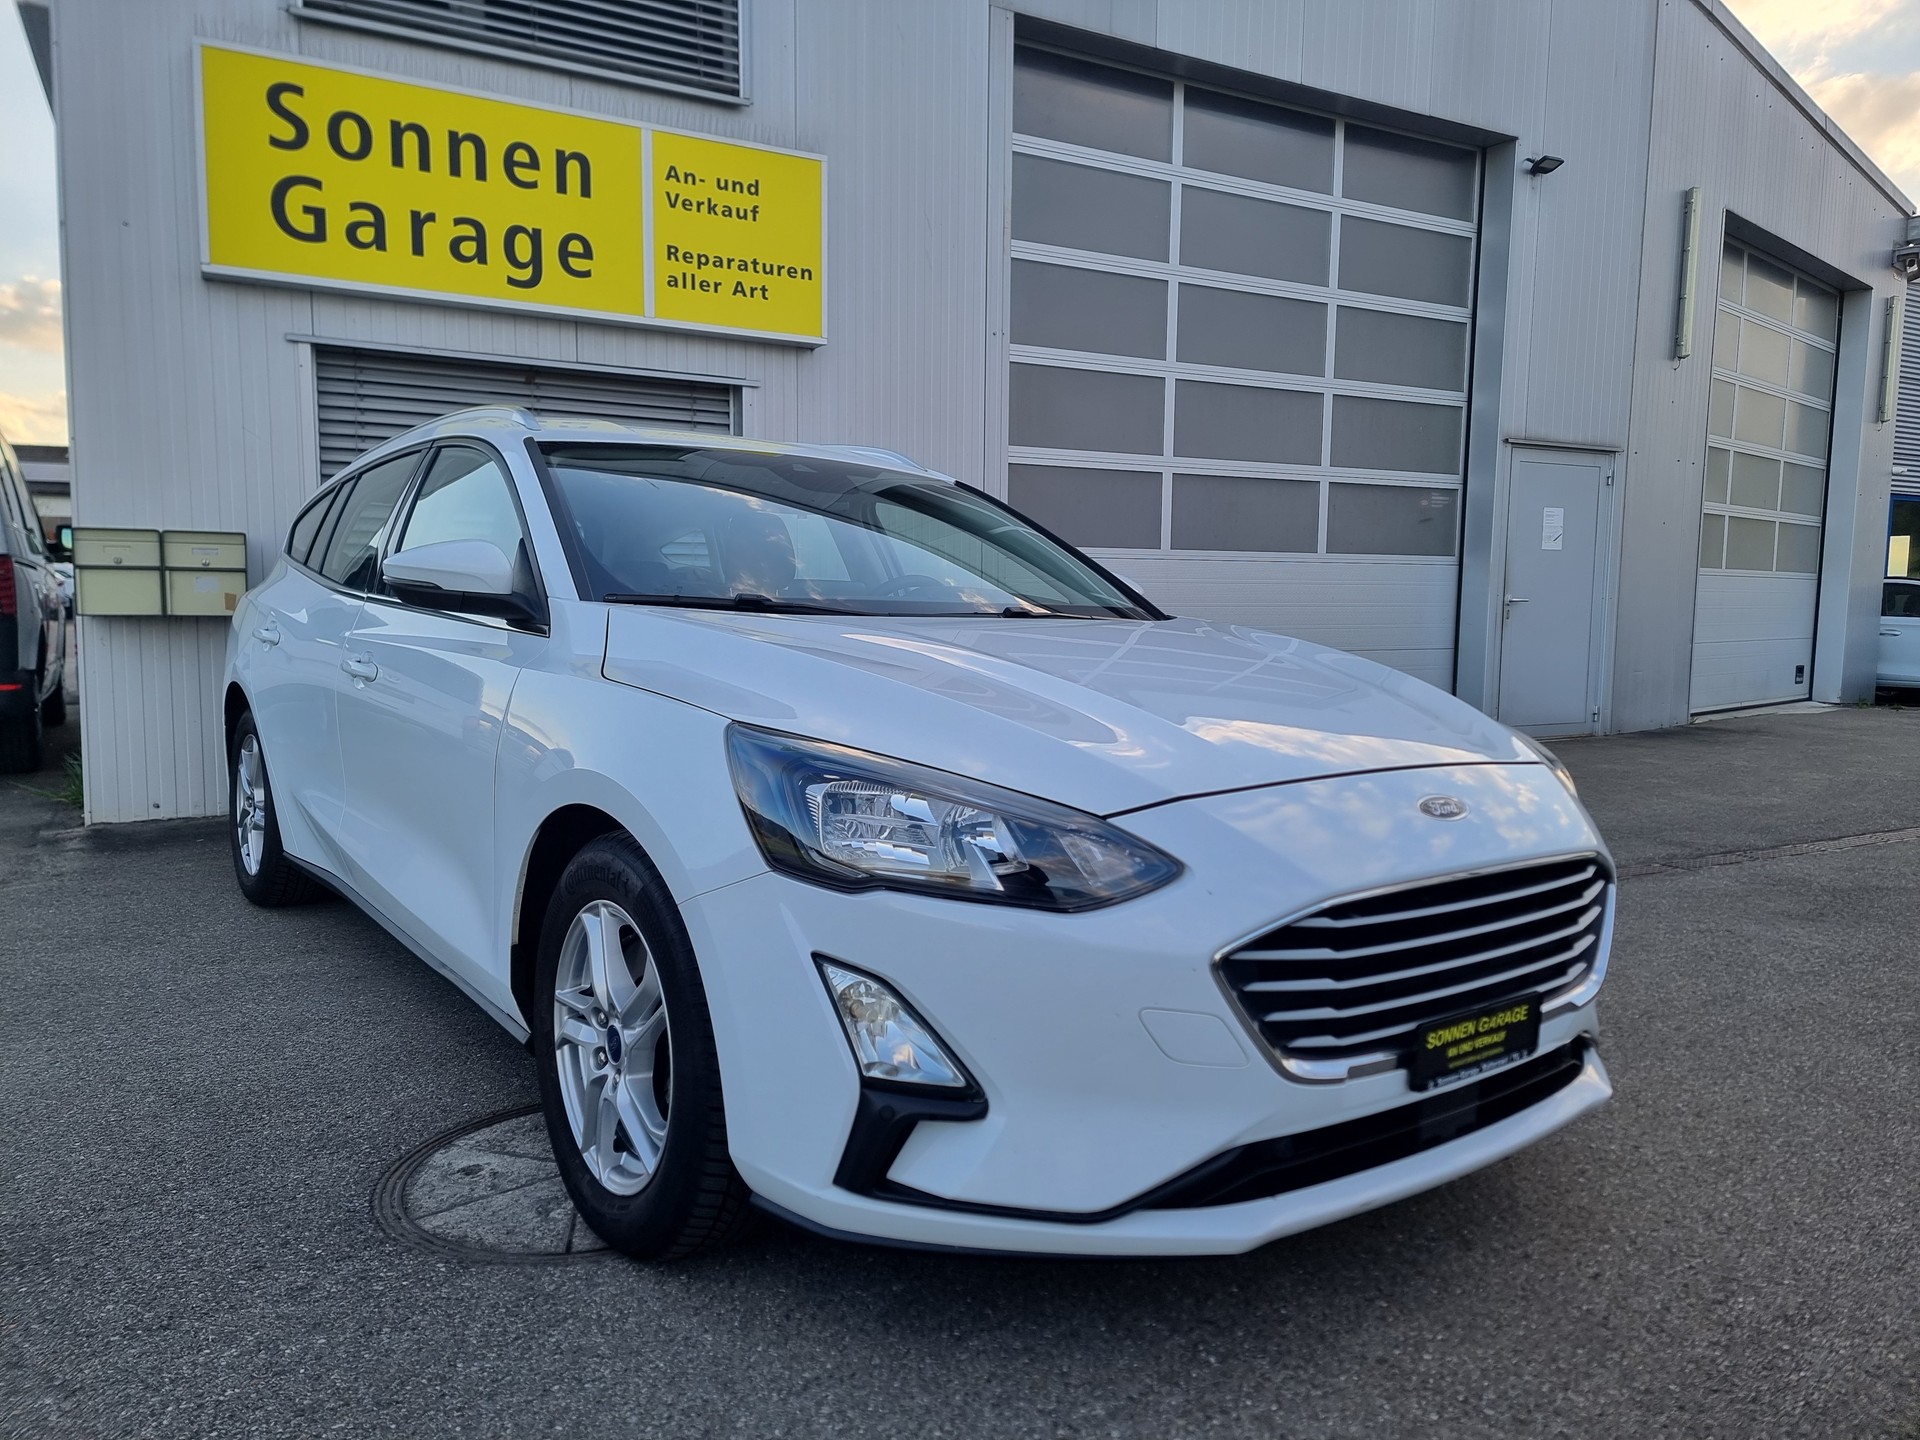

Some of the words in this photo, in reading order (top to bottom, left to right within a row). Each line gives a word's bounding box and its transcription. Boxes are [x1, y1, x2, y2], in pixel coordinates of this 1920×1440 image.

[265, 81, 592, 198] Sonnen
[665, 165, 706, 185] An-
[716, 178, 760, 197] und
[665, 192, 760, 222] Verkauf
[270, 174, 594, 289] Garage
[666, 244, 813, 281] Reparaturen
[666, 271, 722, 294] aller
[731, 281, 769, 301] Art
[1426, 1020, 1477, 1050] SONNEN
[1478, 1005, 1529, 1032] GARAGE
